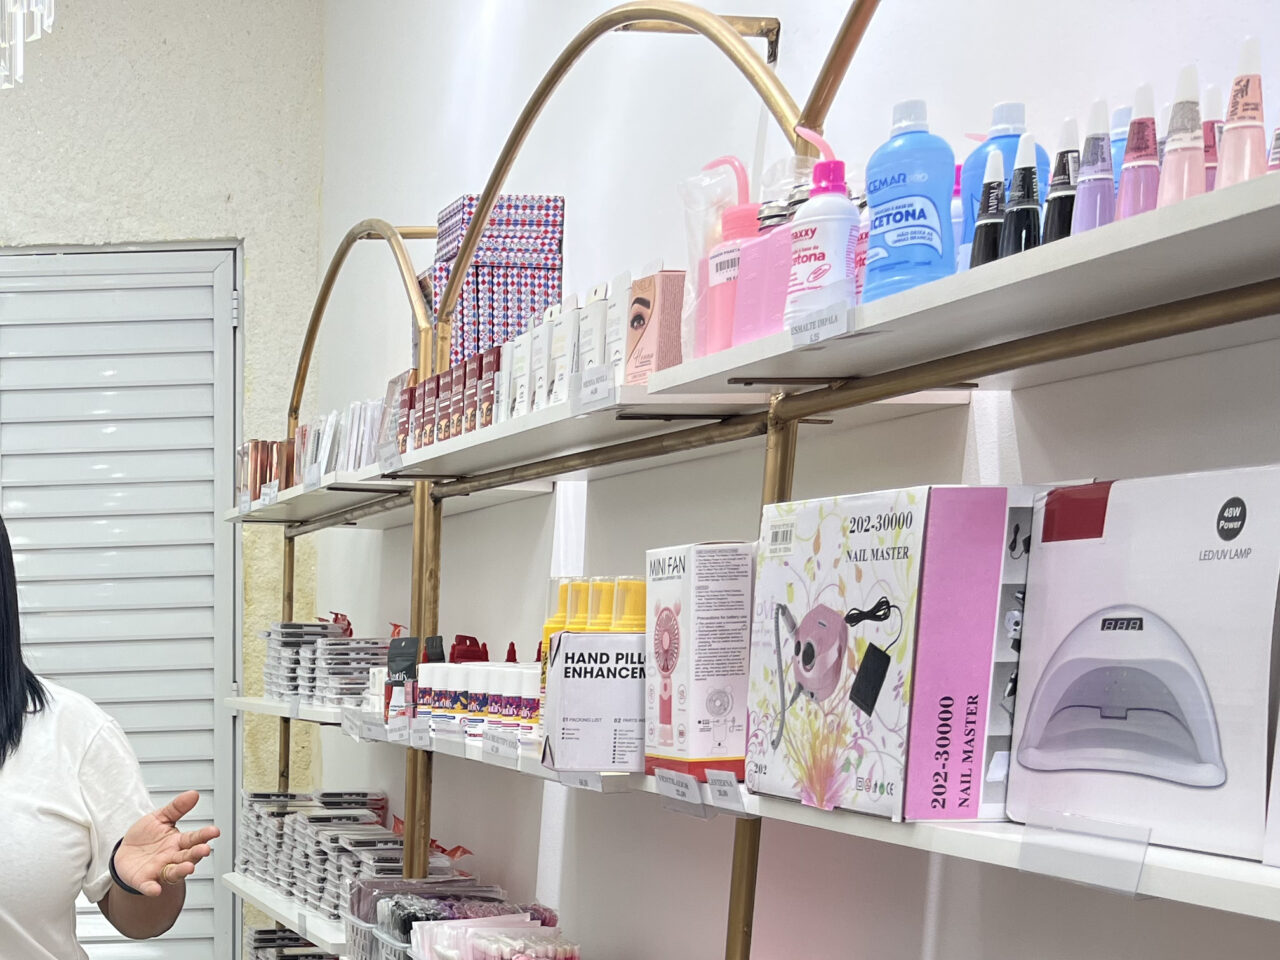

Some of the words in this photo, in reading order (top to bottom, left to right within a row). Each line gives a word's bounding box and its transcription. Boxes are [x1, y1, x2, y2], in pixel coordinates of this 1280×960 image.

[988, 181, 1000, 214] IMPALA
[1223, 506, 1242, 518] 48W
[849, 511, 913, 535] 202-30000
[1218, 520, 1242, 530] Power
[846, 549, 868, 563] NAIL
[870, 546, 909, 562] MASTER
[1199, 549, 1228, 562] LED/UV
[1229, 547, 1252, 560] LAMP
[649, 557, 666, 577] MINI
[668, 554, 686, 575] FAN
[564, 652, 610, 664] HAND
[961, 694, 979, 763] MASTER
[930, 695, 955, 810] 202-30000
[754, 763, 767, 775] 202
[958, 773, 973, 809] NAIL
